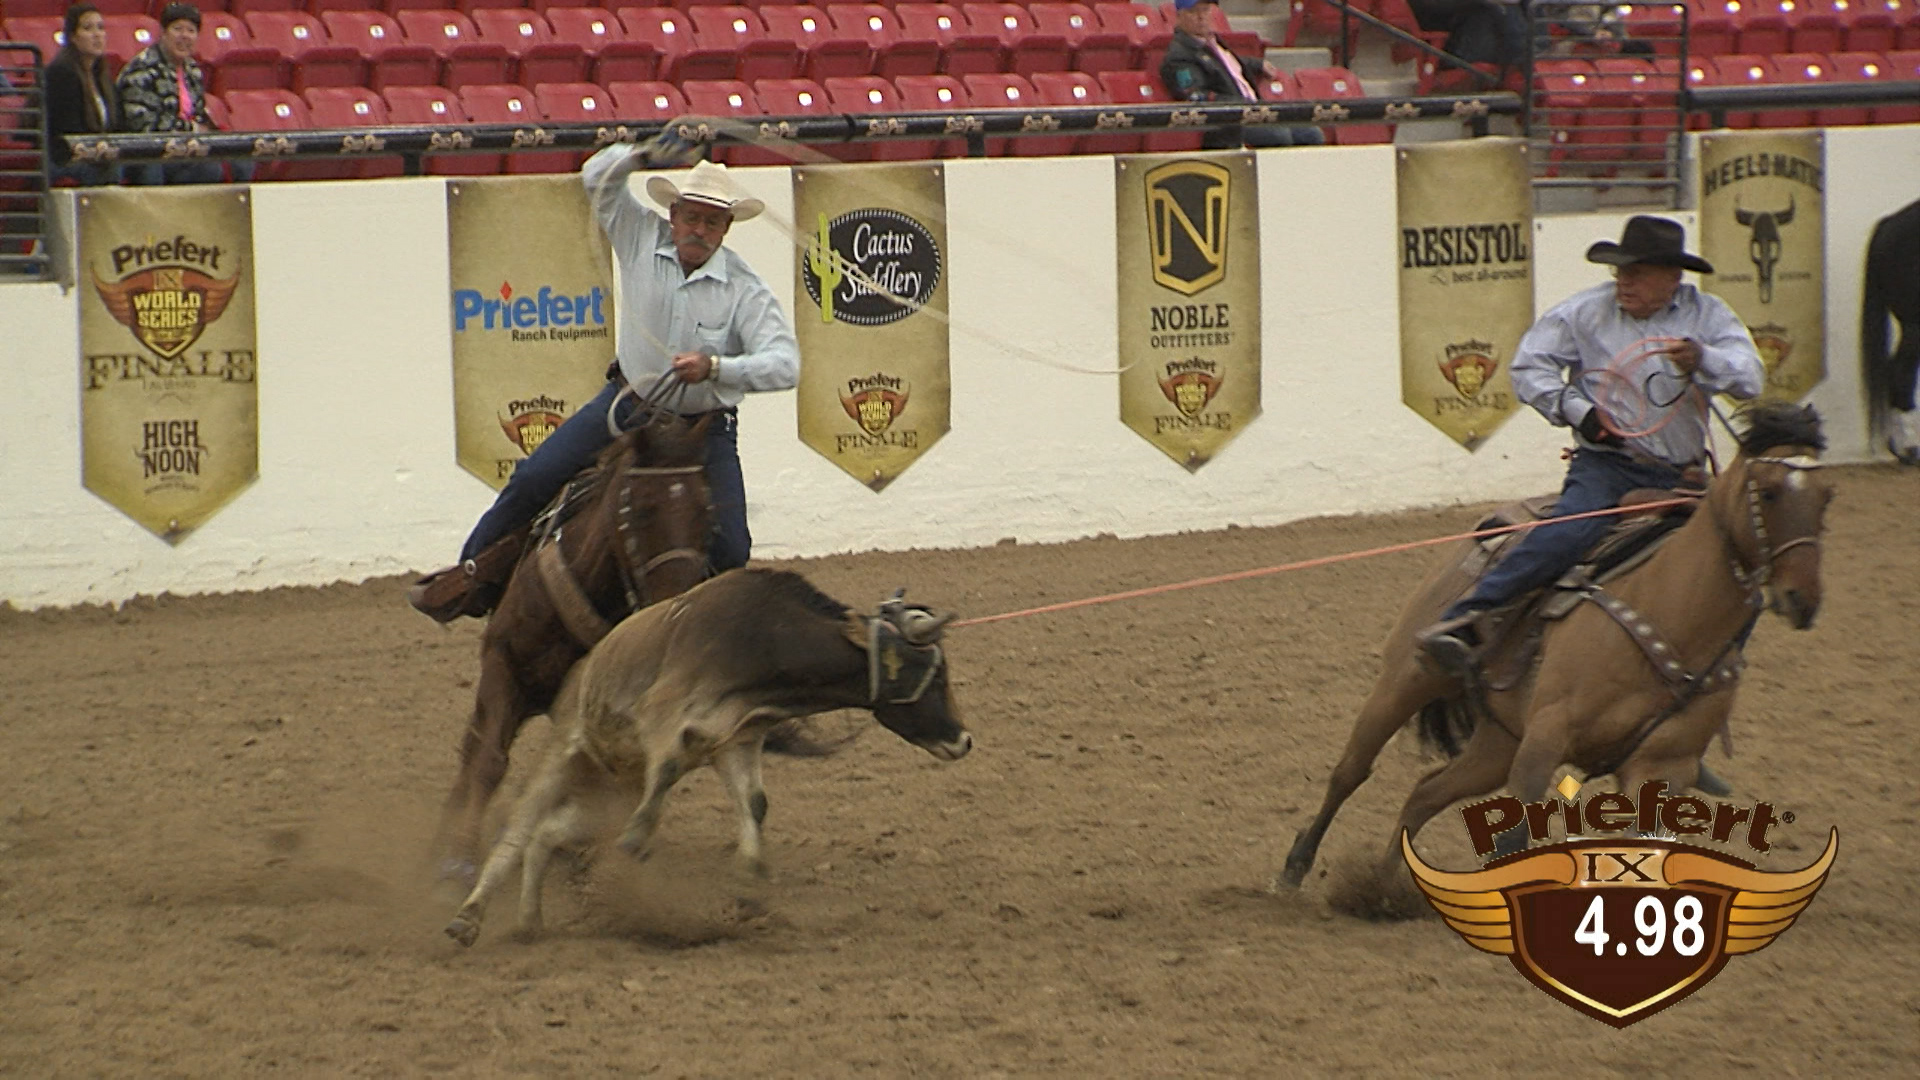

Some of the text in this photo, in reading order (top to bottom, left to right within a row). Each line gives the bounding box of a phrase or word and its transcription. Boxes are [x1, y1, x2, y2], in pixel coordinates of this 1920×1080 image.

[1151, 170, 1224, 283] N
[112, 234, 221, 274] Priefert
[853, 222, 914, 263] Cactus
[1402, 222, 1527, 268] RESISTOL
[841, 261, 922, 303] Saddlery
[133, 291, 201, 310] WORLD
[454, 281, 606, 332] Priefert
[138, 310, 198, 328] SERIES
[1150, 303, 1230, 332] NOBLE
[512, 327, 608, 342] Ranch Equipment
[1151, 332, 1231, 349] OUTFITTERS
[85, 351, 254, 390] FINALE
[847, 372, 901, 393] Priefert
[508, 394, 566, 416] Priefert
[143, 419, 200, 450] HIGH
[1153, 411, 1232, 435] FINALE
[835, 430, 918, 454] FINALE
[143, 449, 200, 479] NOON
